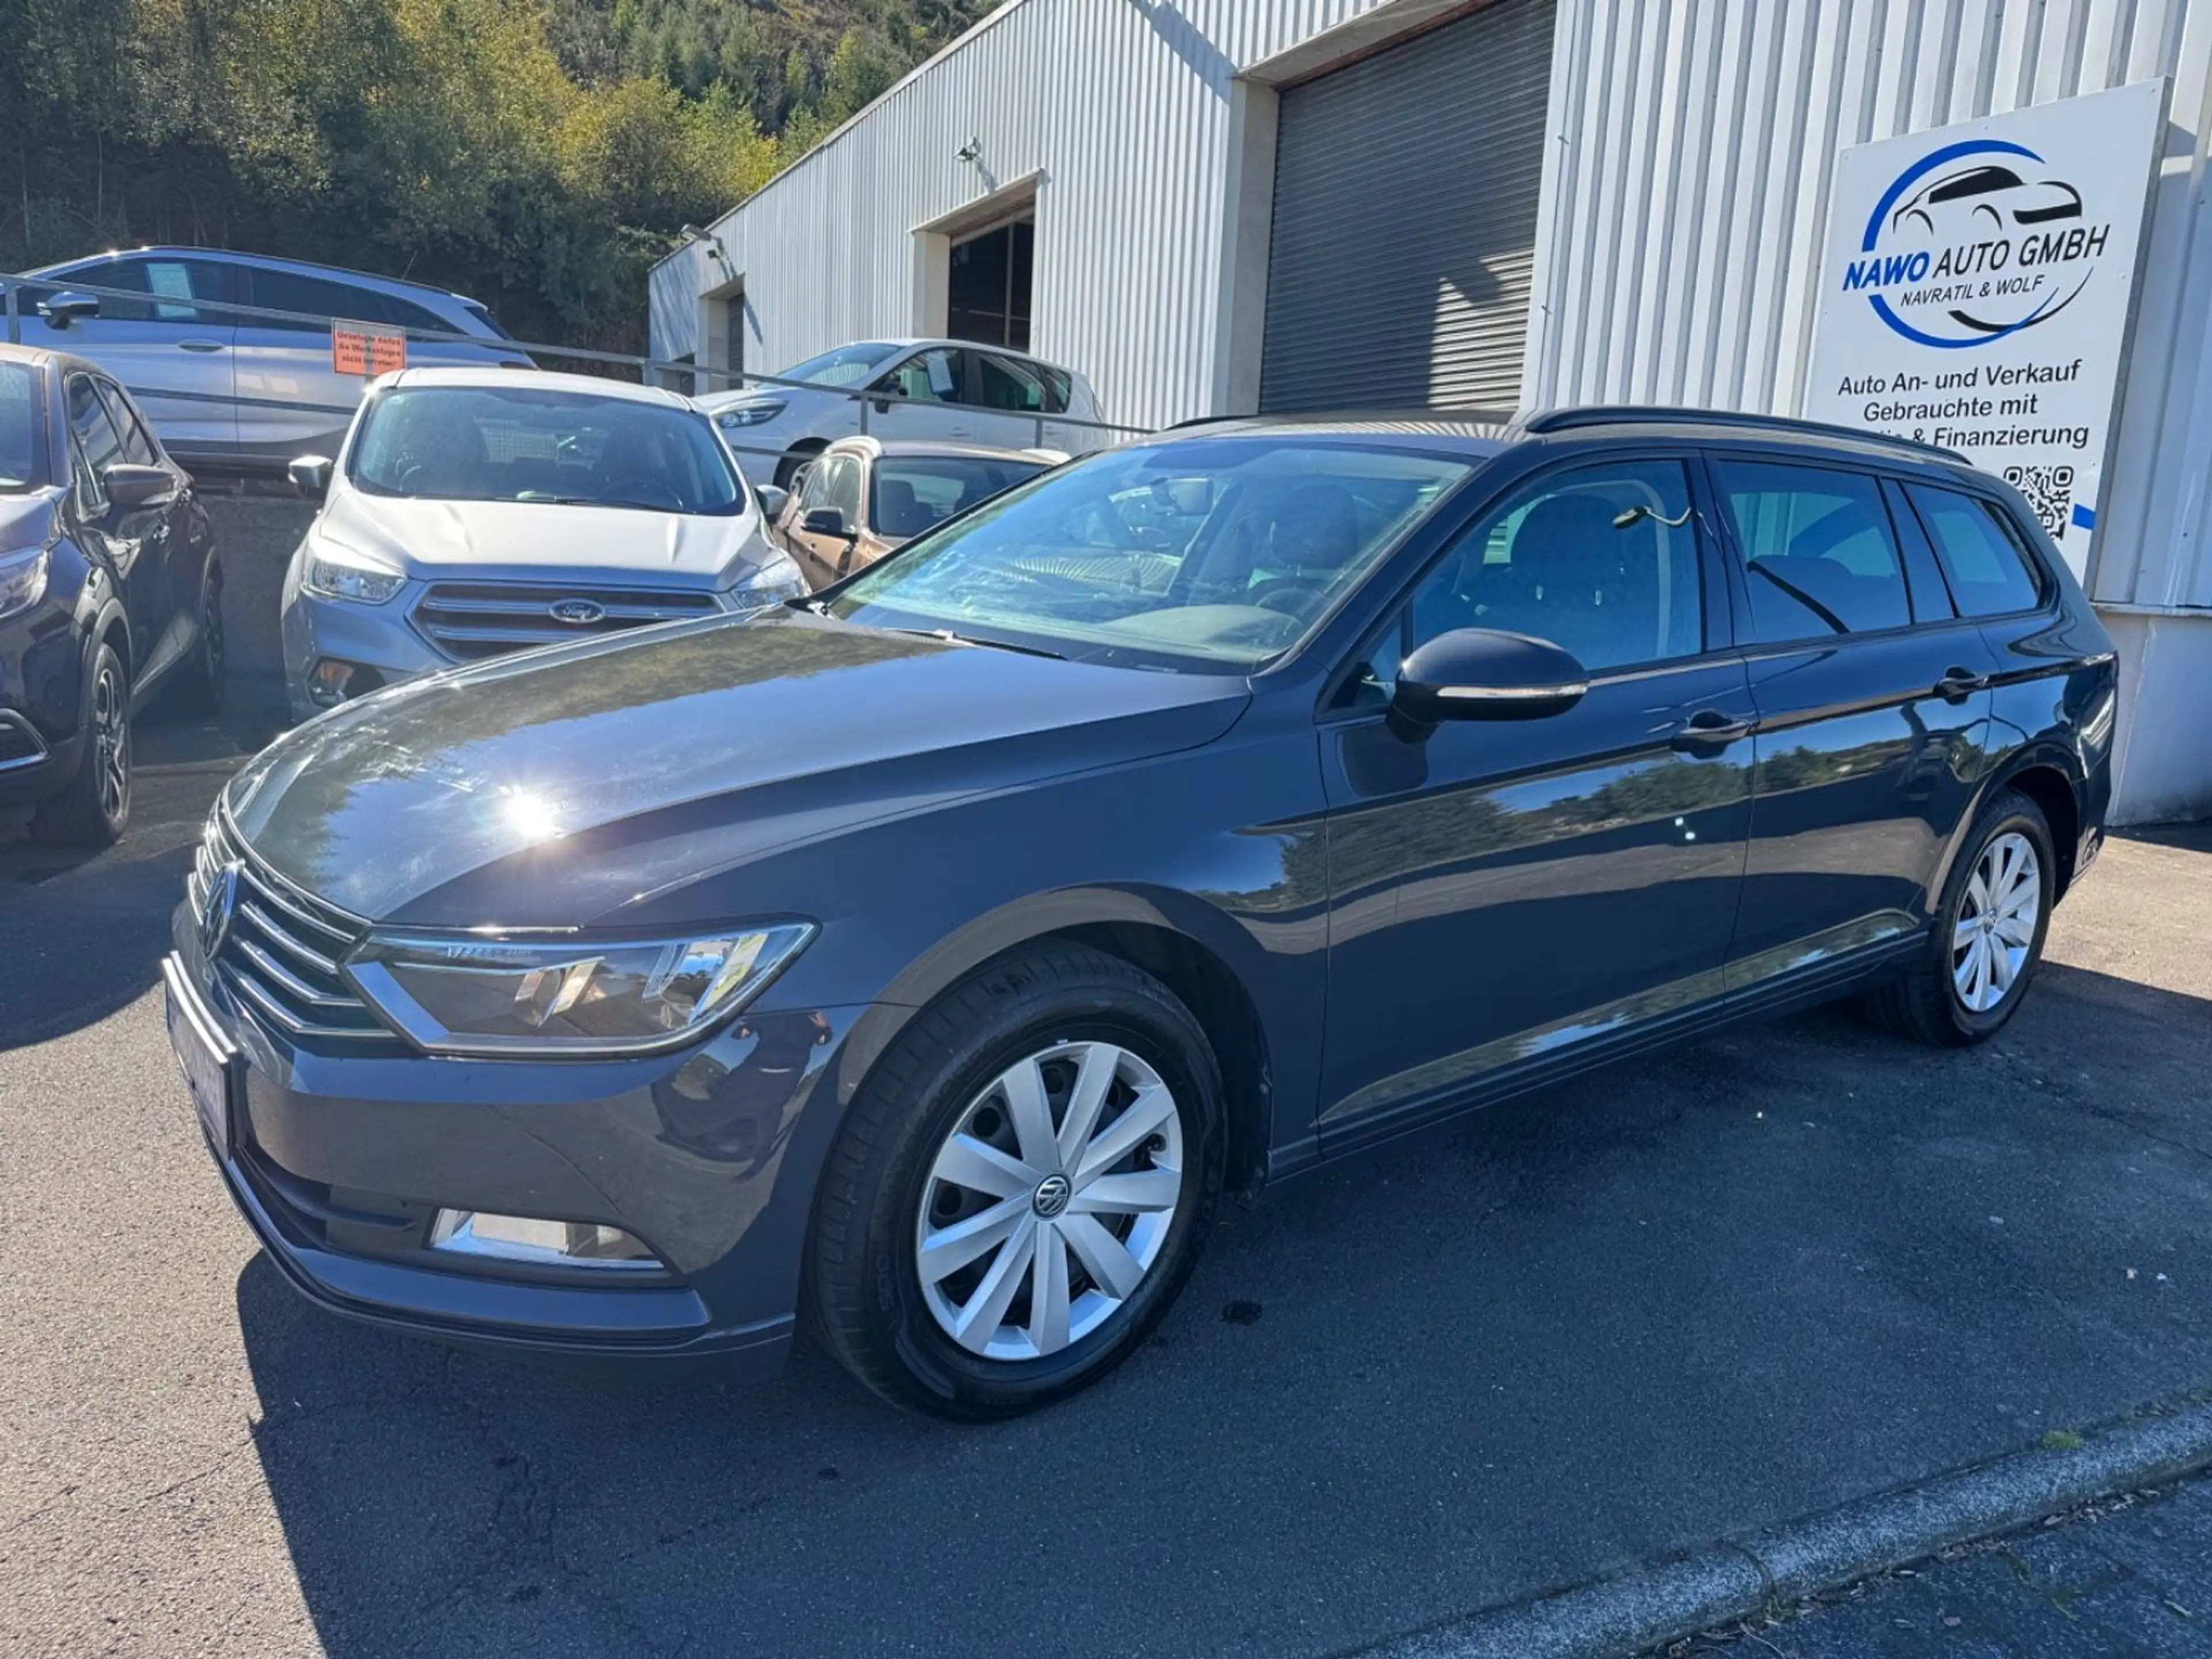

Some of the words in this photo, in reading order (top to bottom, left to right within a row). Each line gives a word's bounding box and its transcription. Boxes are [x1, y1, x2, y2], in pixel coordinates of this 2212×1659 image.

[1842, 251, 1930, 291] NAWO
[1931, 239, 2010, 279] AUTO
[2018, 224, 2111, 267] GMBH
[1900, 287, 1974, 307] NAVRATIL
[1979, 283, 1991, 297] &
[1996, 274, 2045, 296] WOLF
[1838, 374, 1887, 396] Auto
[1891, 372, 1929, 393] An-
[1935, 367, 1979, 389] und
[1986, 358, 2083, 387] Verkauf
[1863, 396, 1993, 421] Gebrauchte
[1999, 393, 2039, 415] mit
[1933, 425, 2089, 449] Finanzierung
